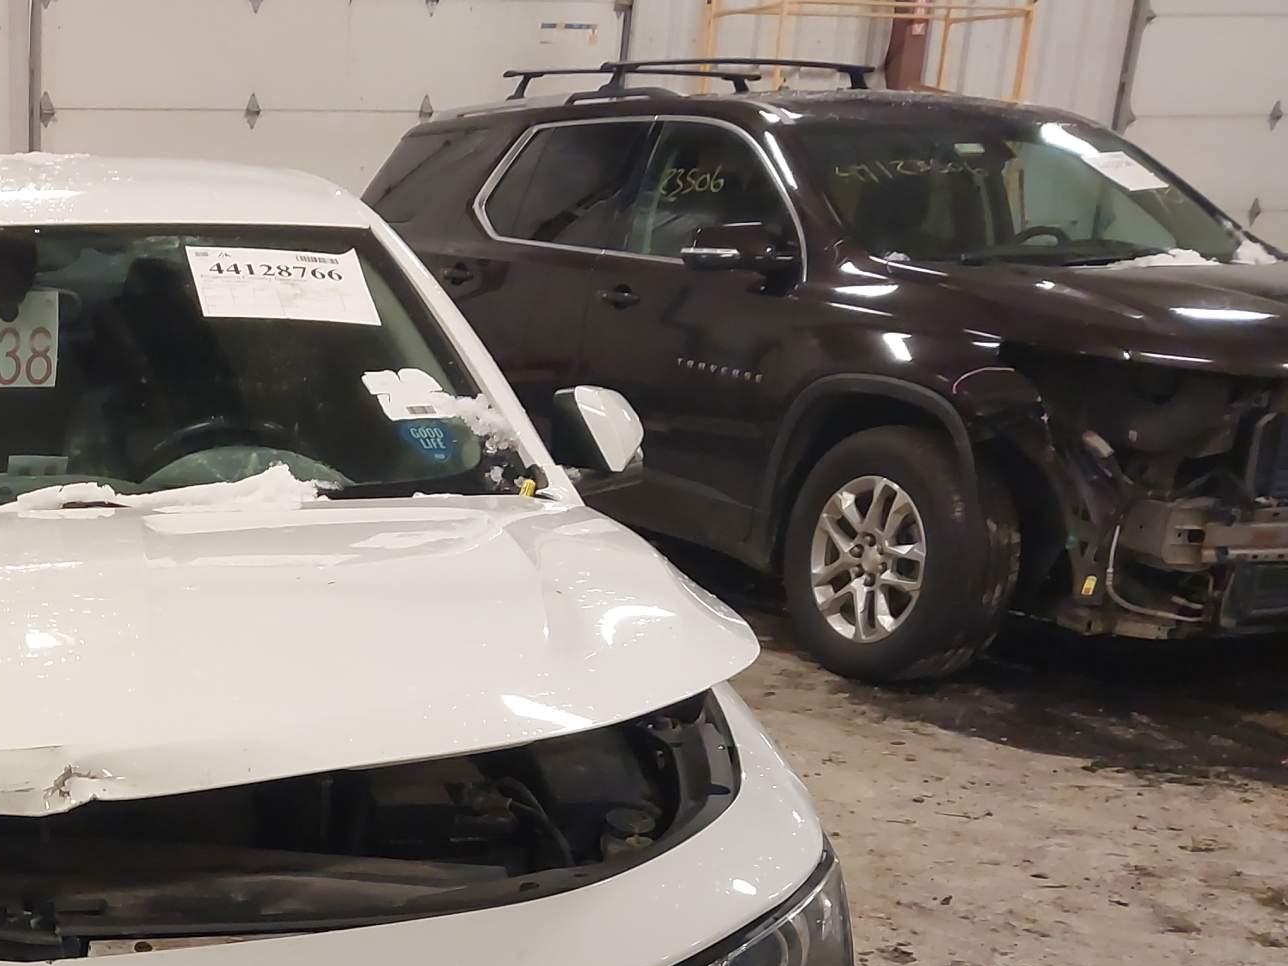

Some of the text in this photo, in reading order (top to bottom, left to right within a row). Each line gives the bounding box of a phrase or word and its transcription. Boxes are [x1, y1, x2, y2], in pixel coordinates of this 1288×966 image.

[658, 164, 725, 200] 23506
[208, 261, 344, 282] 44128766
[409, 426, 445, 439] GOOD
[419, 438, 447, 449] LIFE
